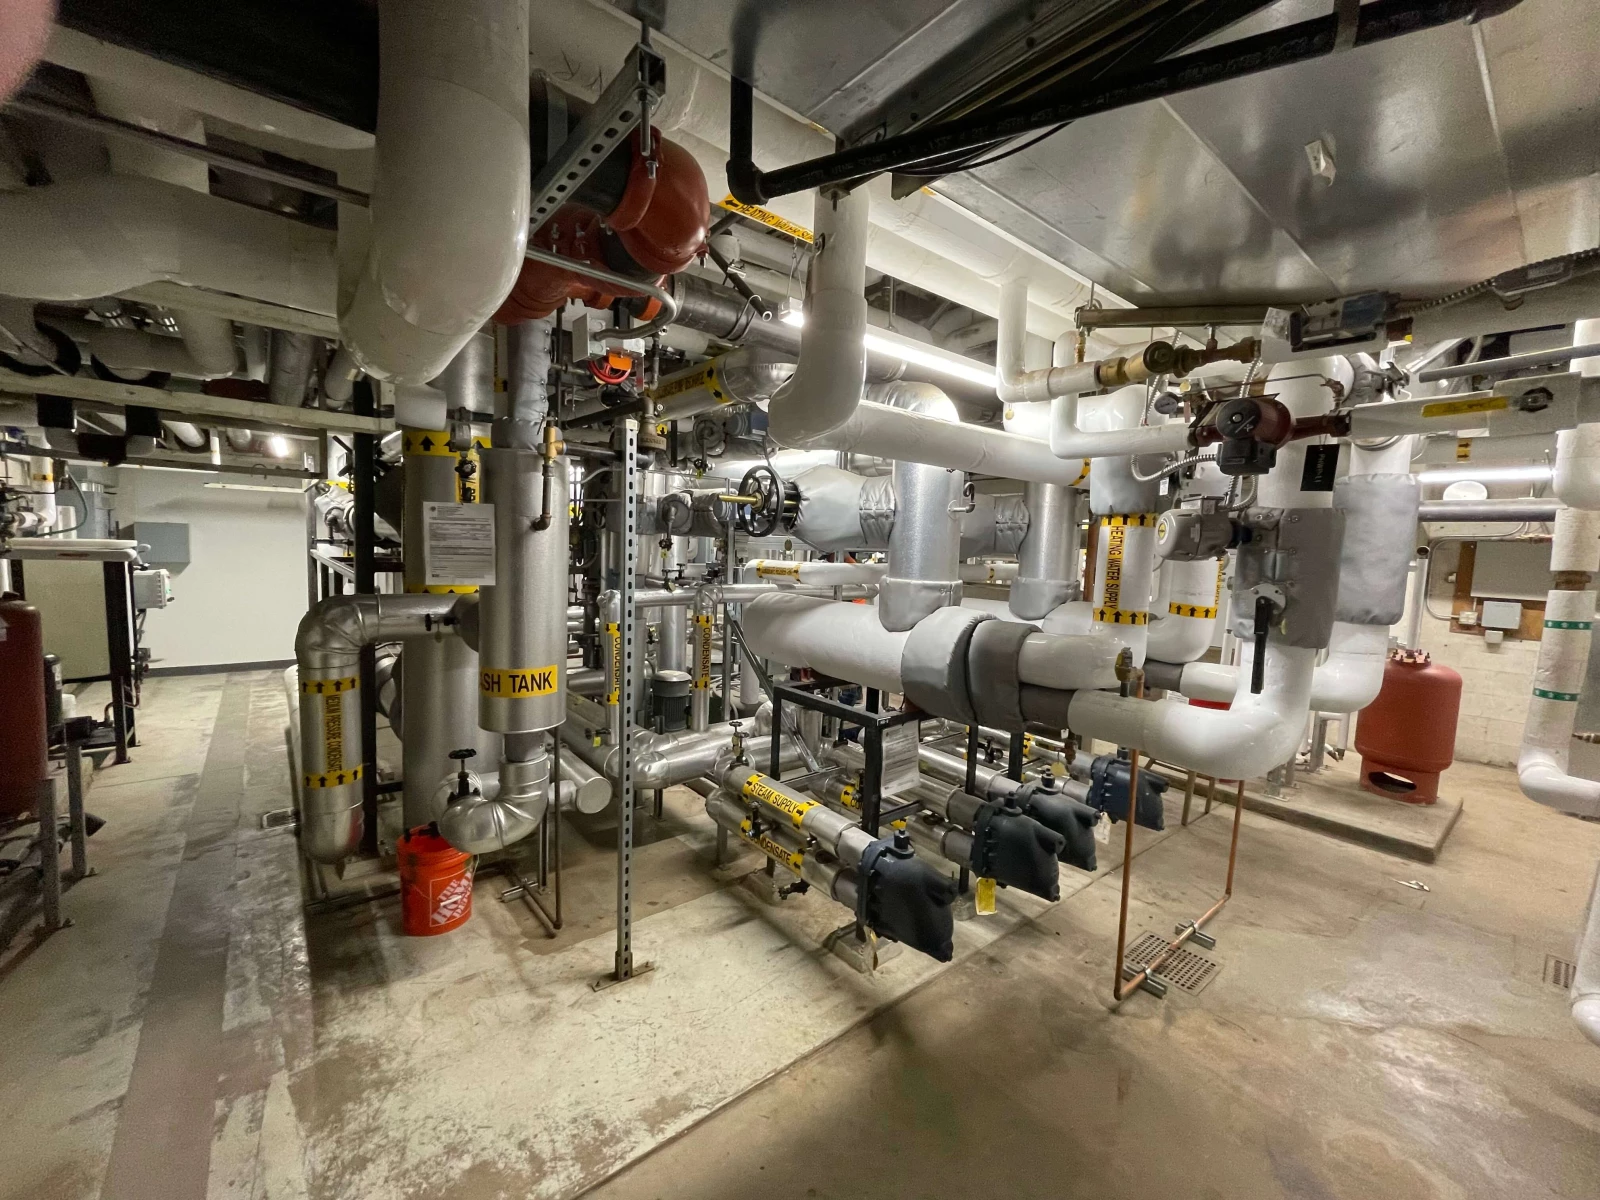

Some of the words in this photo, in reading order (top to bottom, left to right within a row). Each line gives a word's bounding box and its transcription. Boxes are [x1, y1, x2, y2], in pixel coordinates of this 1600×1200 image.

[737, 203, 775, 223] HEATING
[1109, 525, 1124, 556] HEATING
[1106, 558, 1121, 581] WATER
[1103, 583, 1119, 609] SUPPLY
[701, 627, 711, 678] CONDENSATE
[481, 672, 501, 693] SH
[508, 671, 553, 693] TANK
[750, 782, 774, 801] STEAM
[772, 794, 800, 814] SUPPLY
[431, 868, 473, 924] HOME
[437, 879, 460, 901] THE
